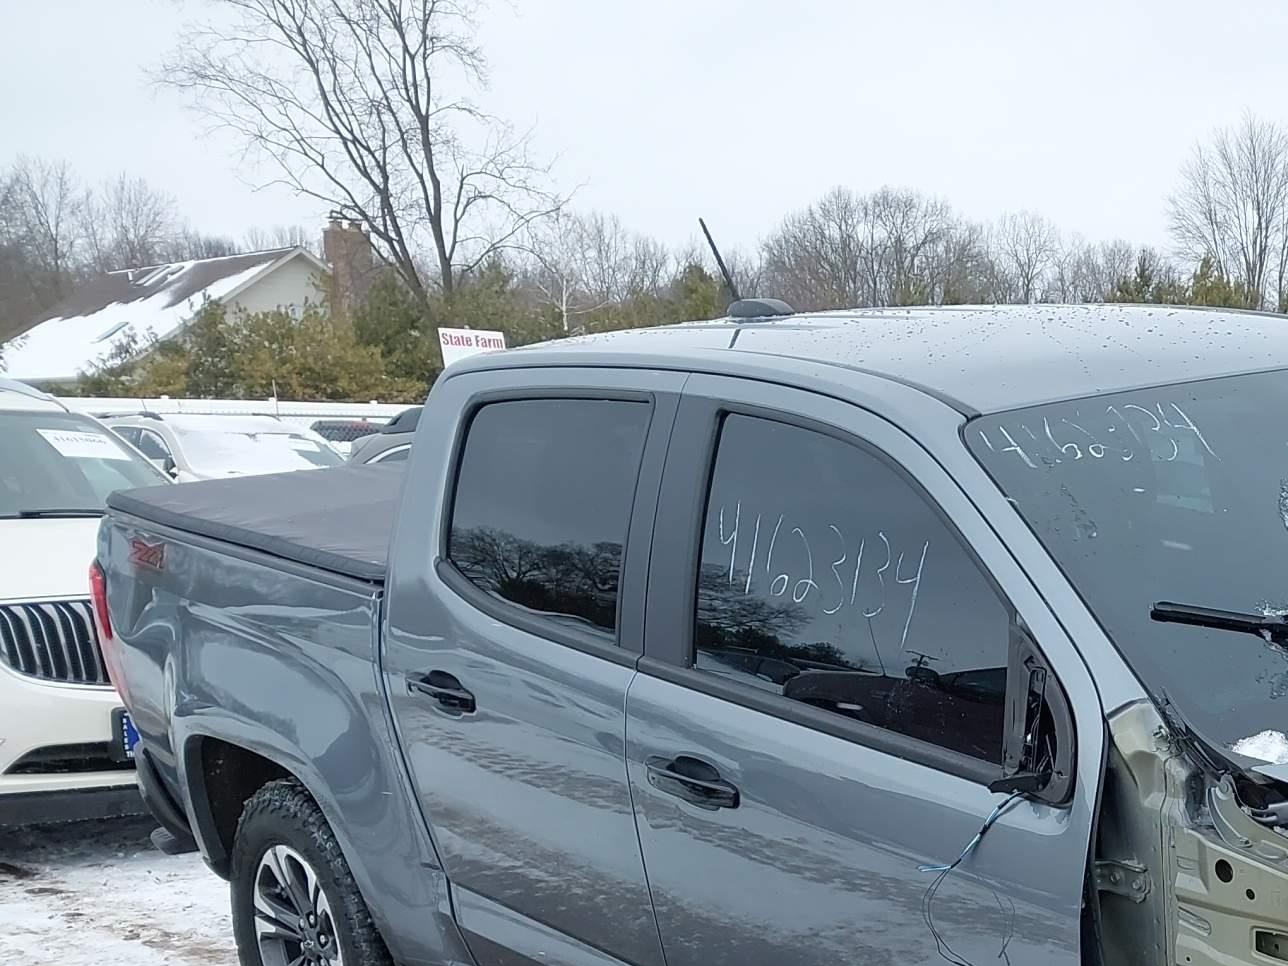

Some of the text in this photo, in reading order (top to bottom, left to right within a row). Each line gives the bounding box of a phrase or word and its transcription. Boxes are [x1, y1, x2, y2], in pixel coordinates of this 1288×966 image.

[441, 332, 504, 349] State Farm
[719, 499, 929, 649] 41623134
